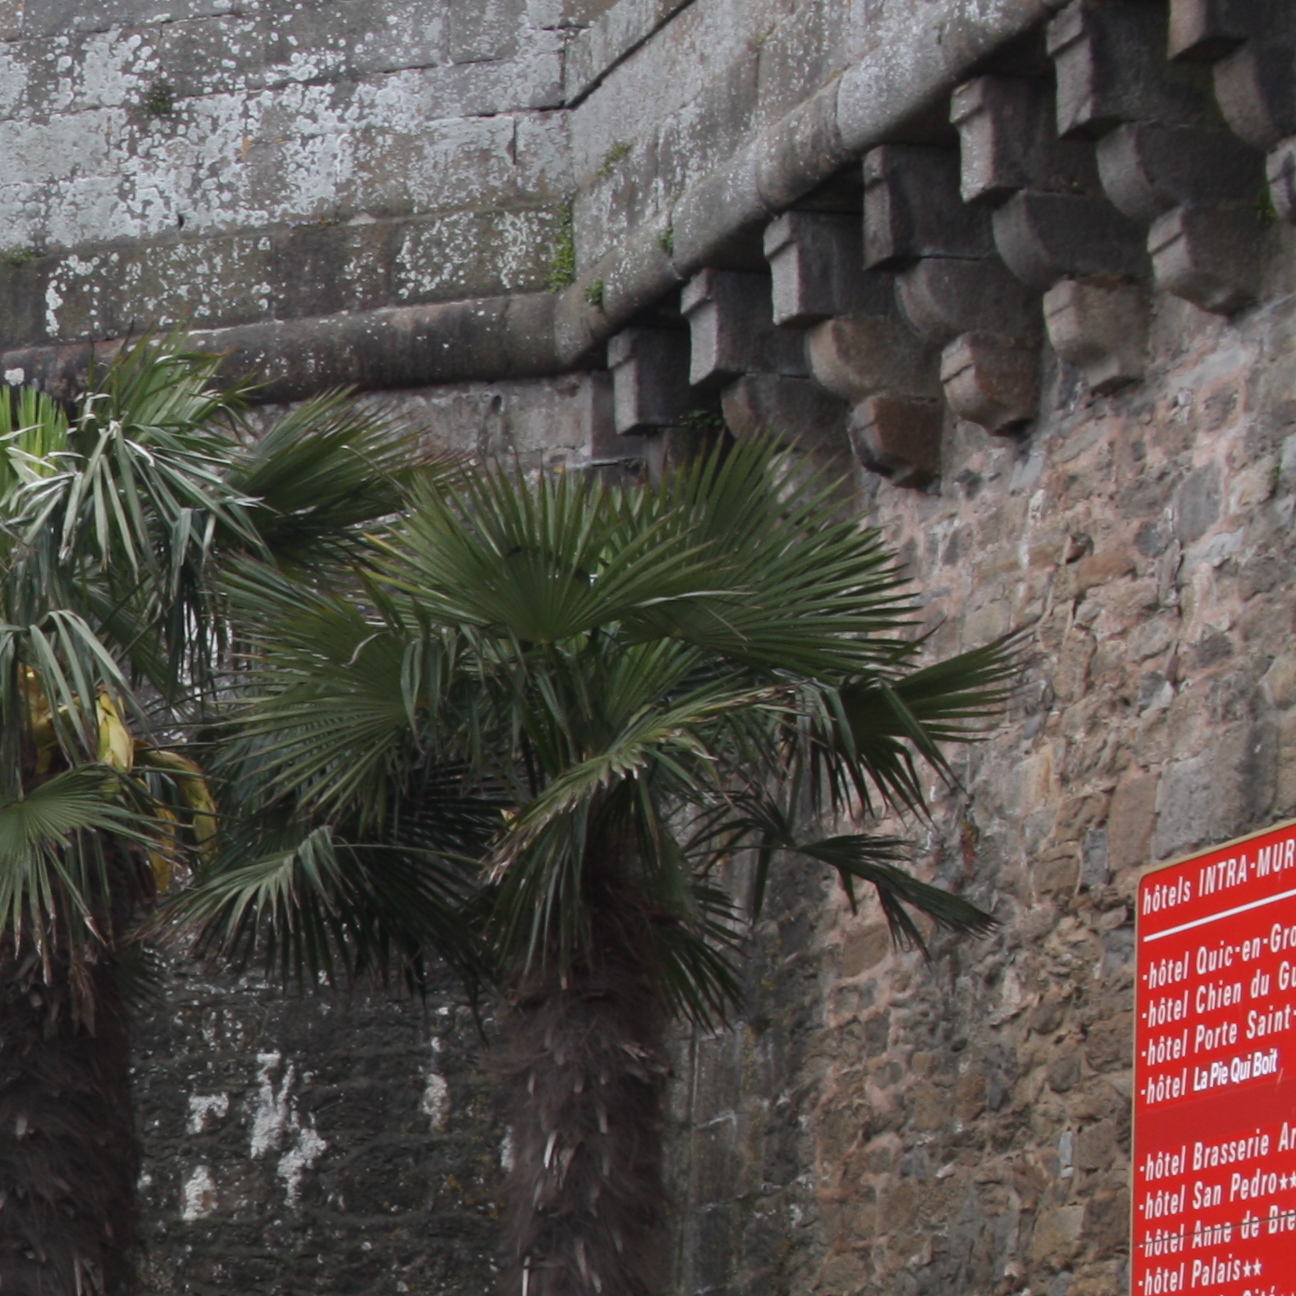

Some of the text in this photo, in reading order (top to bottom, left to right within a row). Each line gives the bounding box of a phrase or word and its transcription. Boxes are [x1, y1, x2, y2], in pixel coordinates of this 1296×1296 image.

[1142, 837, 1296, 916] hôtels INTRA-MUR
[1195, 979, 1242, 1014] Chien
[1250, 968, 1270, 999] du
[1194, 1021, 1238, 1054] Porte
[1192, 1066, 1209, 1092] La
[1209, 1060, 1229, 1088] Pie
[1229, 1053, 1252, 1084] Qui
[1251, 1047, 1278, 1078] Boit
[1192, 1128, 1270, 1171] Brasserie
[1192, 1180, 1222, 1210] San
[1229, 1168, 1278, 1202] Pedro
[1191, 1220, 1233, 1249] Anne
[1240, 1210, 1260, 1240] de
[1268, 1204, 1296, 1235] Bre
[1191, 1253, 1241, 1288] Palais
